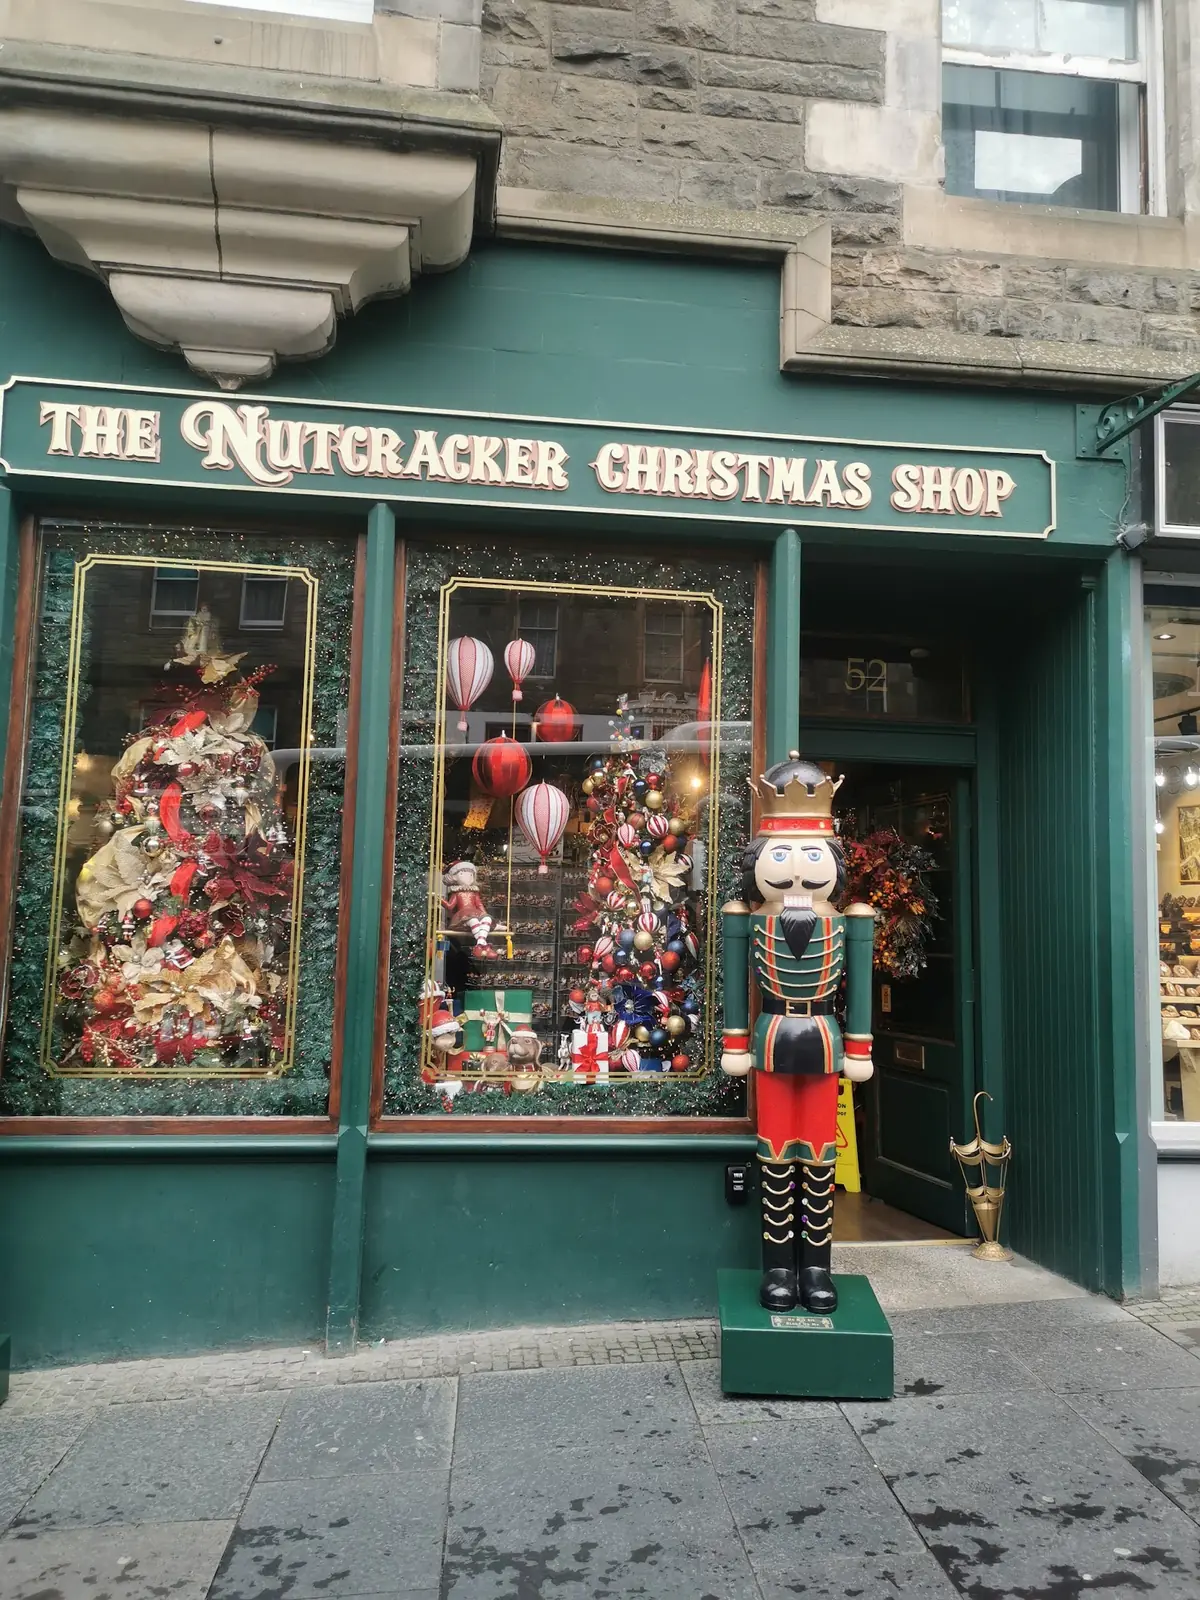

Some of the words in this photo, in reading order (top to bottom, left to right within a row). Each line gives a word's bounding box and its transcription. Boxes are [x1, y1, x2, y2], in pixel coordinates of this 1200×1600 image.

[39, 400, 161, 464] THE
[181, 400, 571, 492] NUTCRACKER
[588, 441, 873, 510] CHRISTMAS
[890, 463, 1018, 518] SHOP
[845, 658, 888, 692] 52
